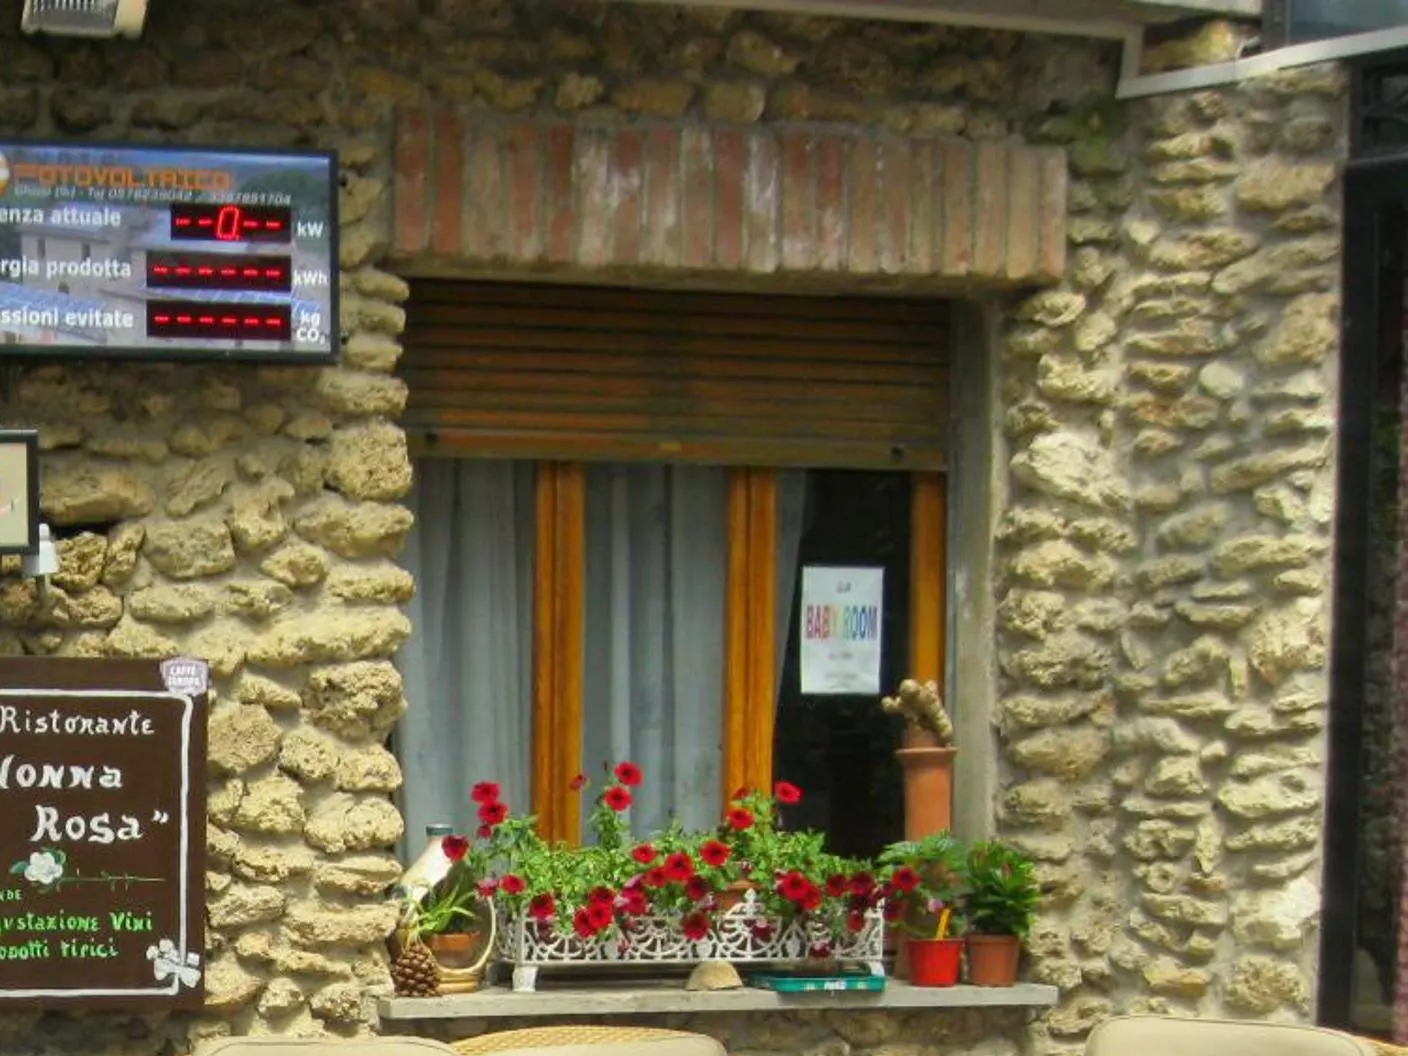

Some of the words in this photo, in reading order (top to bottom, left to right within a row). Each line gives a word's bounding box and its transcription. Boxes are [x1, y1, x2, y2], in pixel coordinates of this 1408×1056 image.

[12, 163, 232, 191] FOTOVOLTAICO
[50, 206, 122, 226] attuale
[296, 221, 324, 237] kW
[46, 257, 132, 280] prodotta
[293, 269, 328, 286] kWh
[65, 308, 135, 329] evitate
[300, 309, 321, 327] kg
[806, 605, 839, 640] BABY
[843, 605, 878, 641] ROOM
[109, 911, 153, 931] Vini
